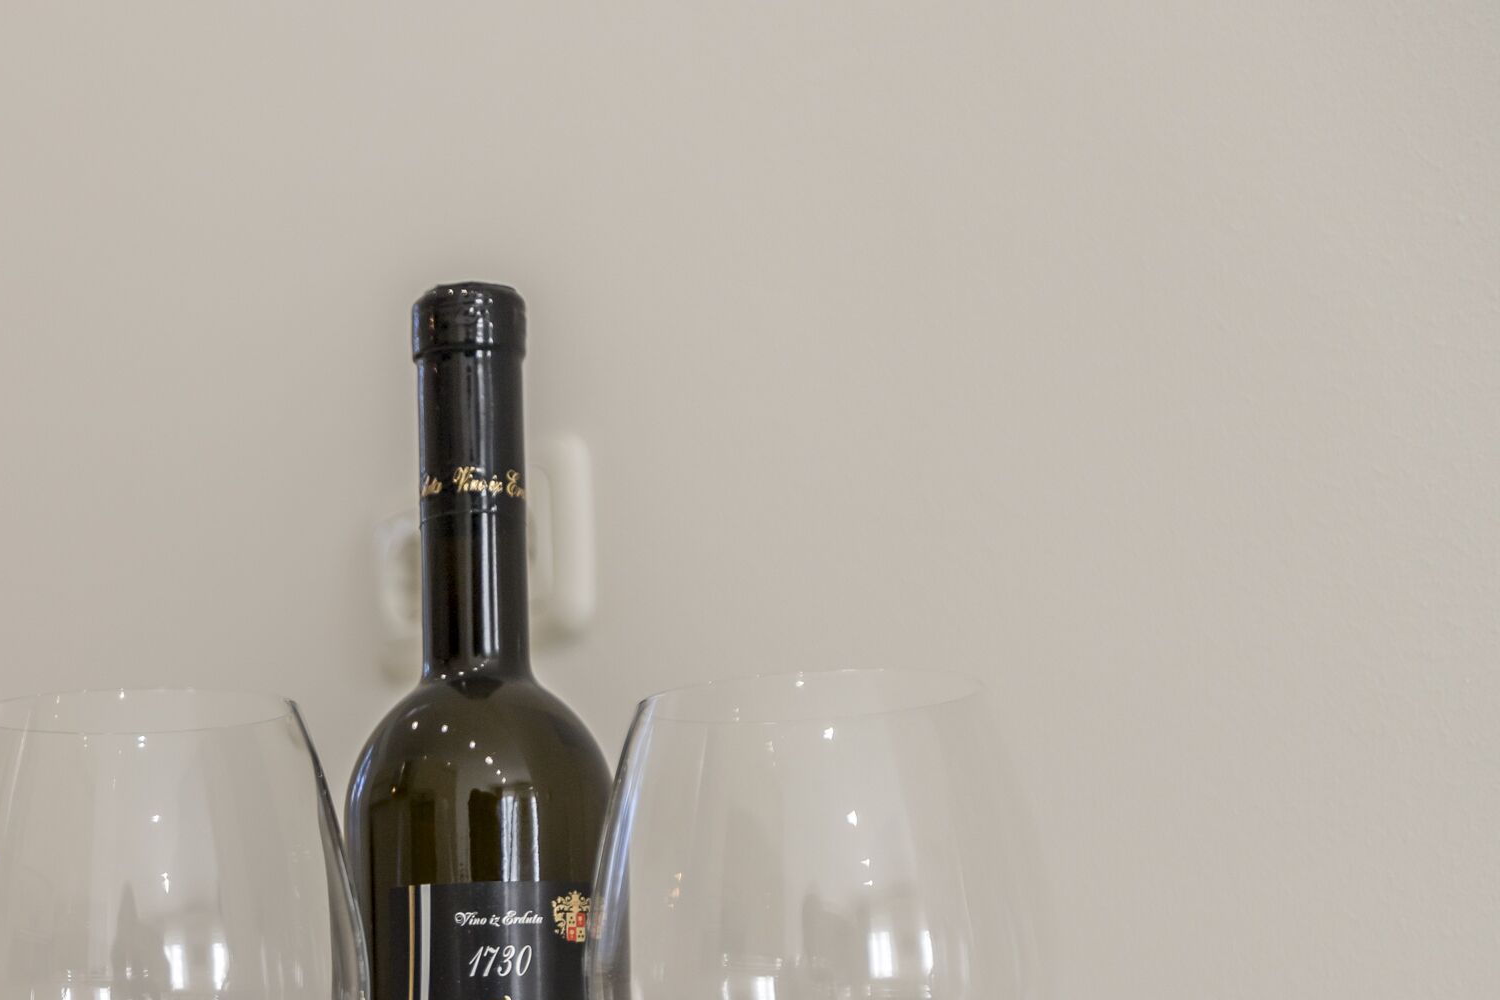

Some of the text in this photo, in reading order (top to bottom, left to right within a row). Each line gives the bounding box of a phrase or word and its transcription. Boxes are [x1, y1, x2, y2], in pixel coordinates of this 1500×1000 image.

[454, 910, 544, 928] Vino iz Erduta
[468, 944, 533, 977] 1730
